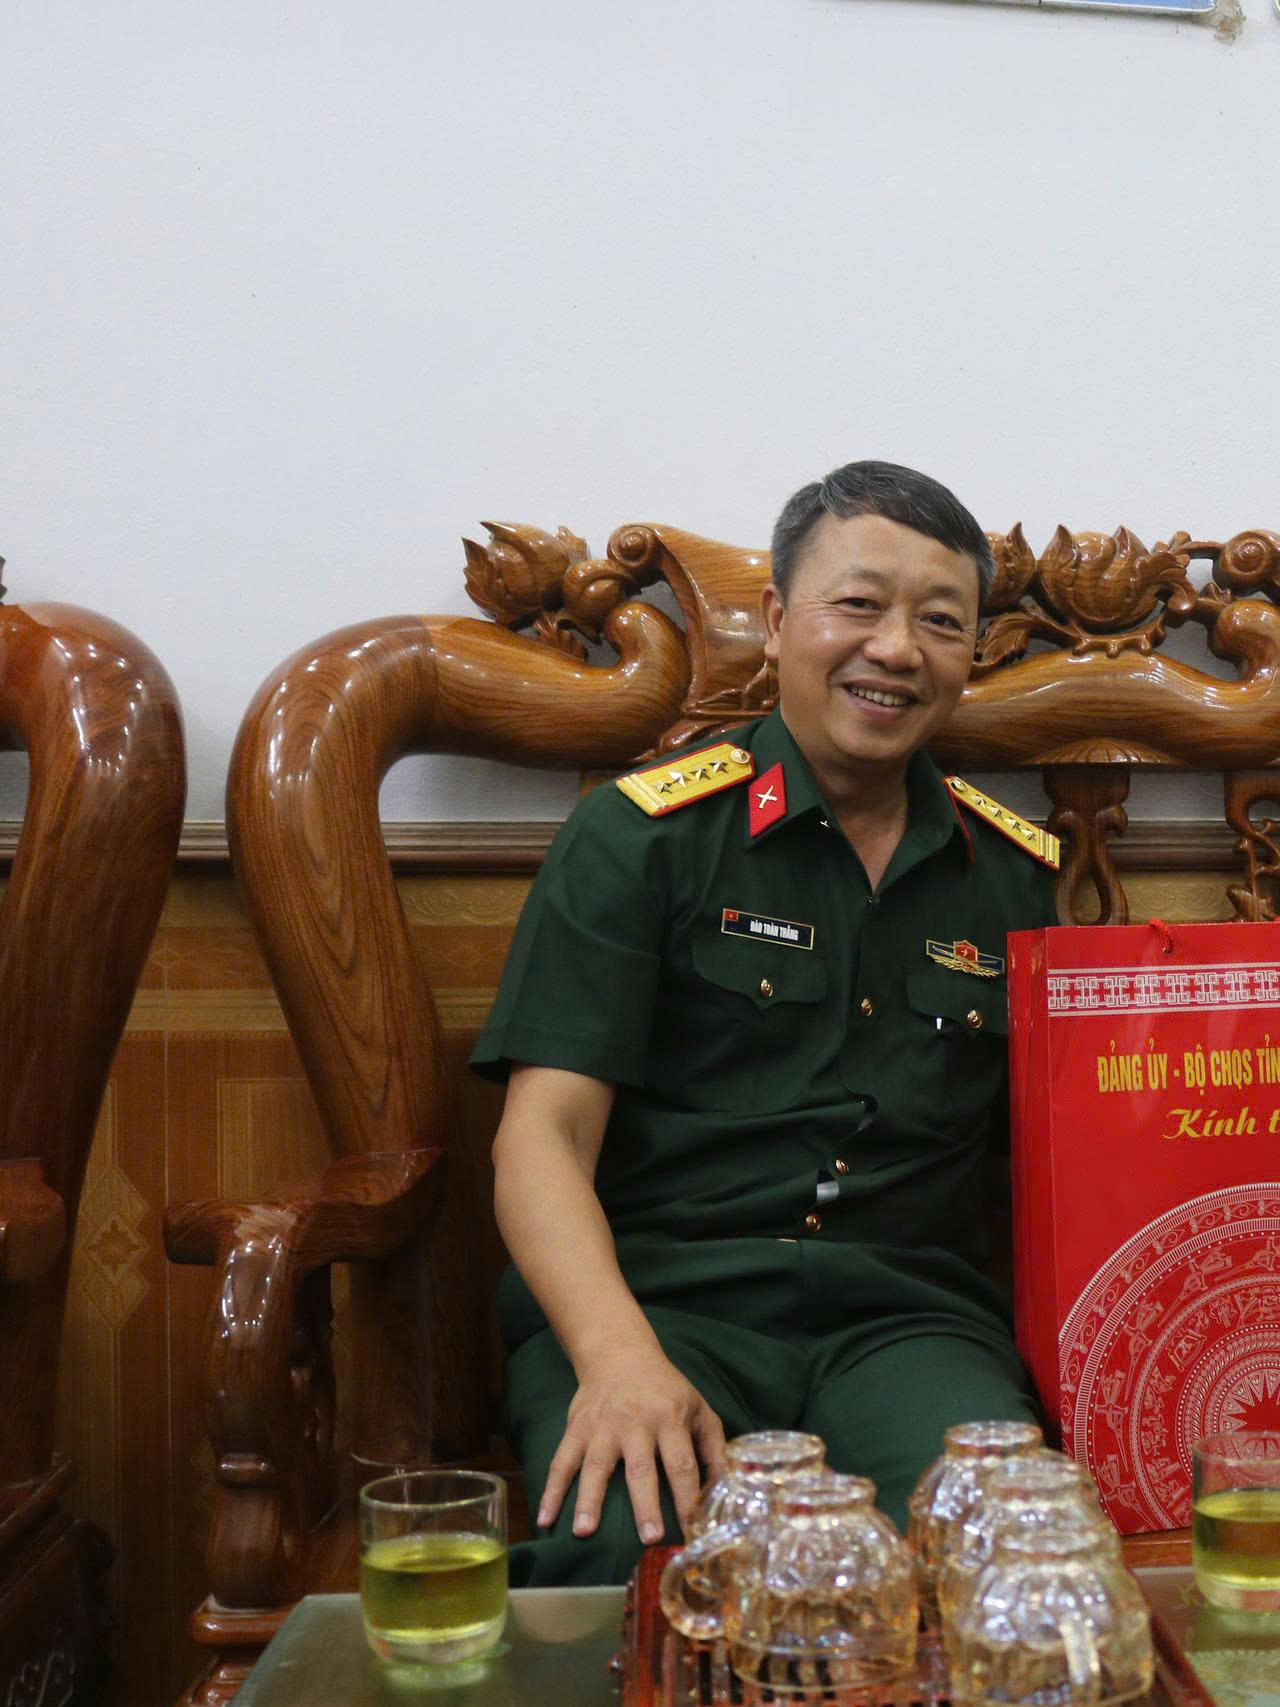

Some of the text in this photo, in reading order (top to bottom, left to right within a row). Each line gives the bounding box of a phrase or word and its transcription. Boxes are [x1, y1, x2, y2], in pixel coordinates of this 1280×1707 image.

[1097, 1040, 1143, 1093] ĐẢNG
[1147, 1038, 1168, 1091] ỦY
[1184, 1043, 1206, 1096] BỘ
[1209, 1048, 1253, 1089] CHQS
[1162, 1106, 1260, 1140] Kính
